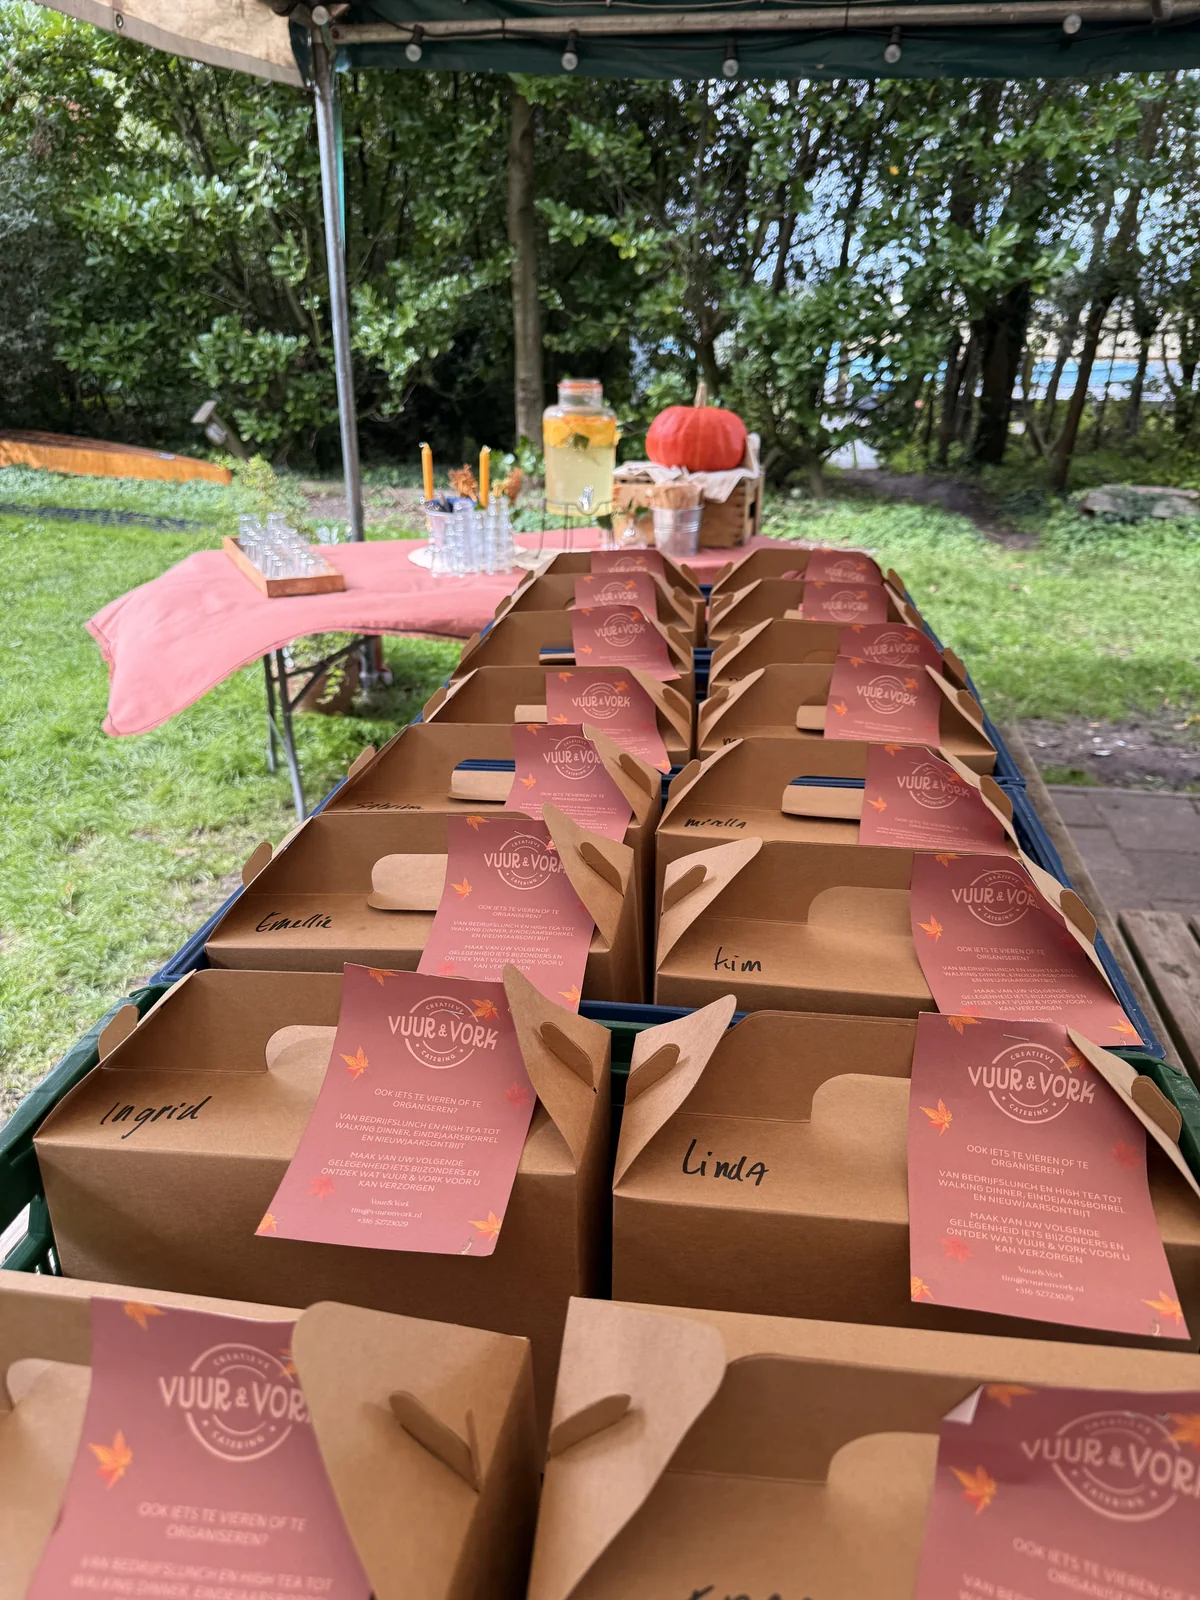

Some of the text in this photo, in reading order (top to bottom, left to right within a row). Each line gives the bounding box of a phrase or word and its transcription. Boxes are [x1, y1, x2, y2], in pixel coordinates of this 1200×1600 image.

[572, 696, 598, 707] VUUR
[604, 696, 630, 707] VORK
[857, 686, 882, 699] VUUR
[890, 690, 918, 706] VORK
[543, 751, 573, 764] VUUR
[574, 753, 580, 761] &
[897, 775, 970, 798] VUUR & VORK
[511, 839, 541, 848] CREATIEVE
[484, 852, 520, 869] VUUR
[522, 857, 530, 867] &
[511, 877, 538, 885] CATERING
[951, 887, 994, 904] VUUR
[996, 892, 1004, 902] &
[983, 912, 1014, 921] CATERING
[425, 1002, 465, 1016] CREATIEVE
[388, 1016, 499, 1050] VUUR & VORK
[421, 1050, 456, 1063] CATERING
[1010, 1050, 1055, 1064] CREATIEVE
[968, 1066, 1096, 1104] VUUR & VORK
[374, 1088, 394, 1097] OOK
[395, 1091, 412, 1099] IETS
[415, 1093, 425, 1101] TE
[427, 1095, 456, 1105] VIEREN
[472, 1100, 482, 1108] TE
[393, 1101, 458, 1114] ORGANISEREN?
[100, 1096, 212, 1140] Ingrid
[1009, 1103, 1049, 1118] CATERING
[335, 1122, 499, 1144] WALKING DINNER, EINDEJAARSBORREL
[339, 1113, 357, 1121] VAN
[359, 1115, 427, 1128] BEDRIJFSLUNCH
[442, 1123, 463, 1131] HIGH
[483, 1127, 501, 1135] TOT
[375, 1136, 466, 1149] NIEUWJAARSONTBIJT
[350, 1152, 464, 1167] MAAK VAN UW VOLGENDE
[967, 1144, 1089, 1169] OOK IETS TE VIEREN OF TE
[321, 1168, 357, 1177] ONTDEK
[360, 1170, 381, 1179] WAT
[382, 1172, 407, 1181] VUUR
[418, 1175, 443, 1183] VORK
[445, 1177, 471, 1185] VOOR
[328, 1159, 480, 1177] GELEGENHEID IETS BIJZONDERS EN
[991, 1158, 1065, 1176] ORGANISEREN?
[358, 1180, 435, 1192] KAN VERZORGEN
[938, 1179, 1126, 1213] WALKING DINNER, EINDEJAARSBORREL
[939, 1170, 1122, 1204] VAN BEDRIJFSLUNCH EN HIGH TEA TOT
[973, 1193, 1091, 1218] EN NIEUWJAARSONTBIJT
[949, 1218, 1124, 1251] GELEGENHEID IETS BIJZONDERS EN
[970, 1212, 1100, 1238] MAAK VAN UW VOLGENDE
[946, 1227, 1130, 1261] ONTDEK WAT VUUR & VORK VOOR U
[994, 1244, 1083, 1264] KAN VERZORGEN
[159, 1375, 313, 1425] VUUR & VOR
[1020, 1437, 1104, 1467] VUUR
[1108, 1446, 1125, 1468] &
[138, 1501, 307, 1531] OOK IETS TE VIEREN OF TE
